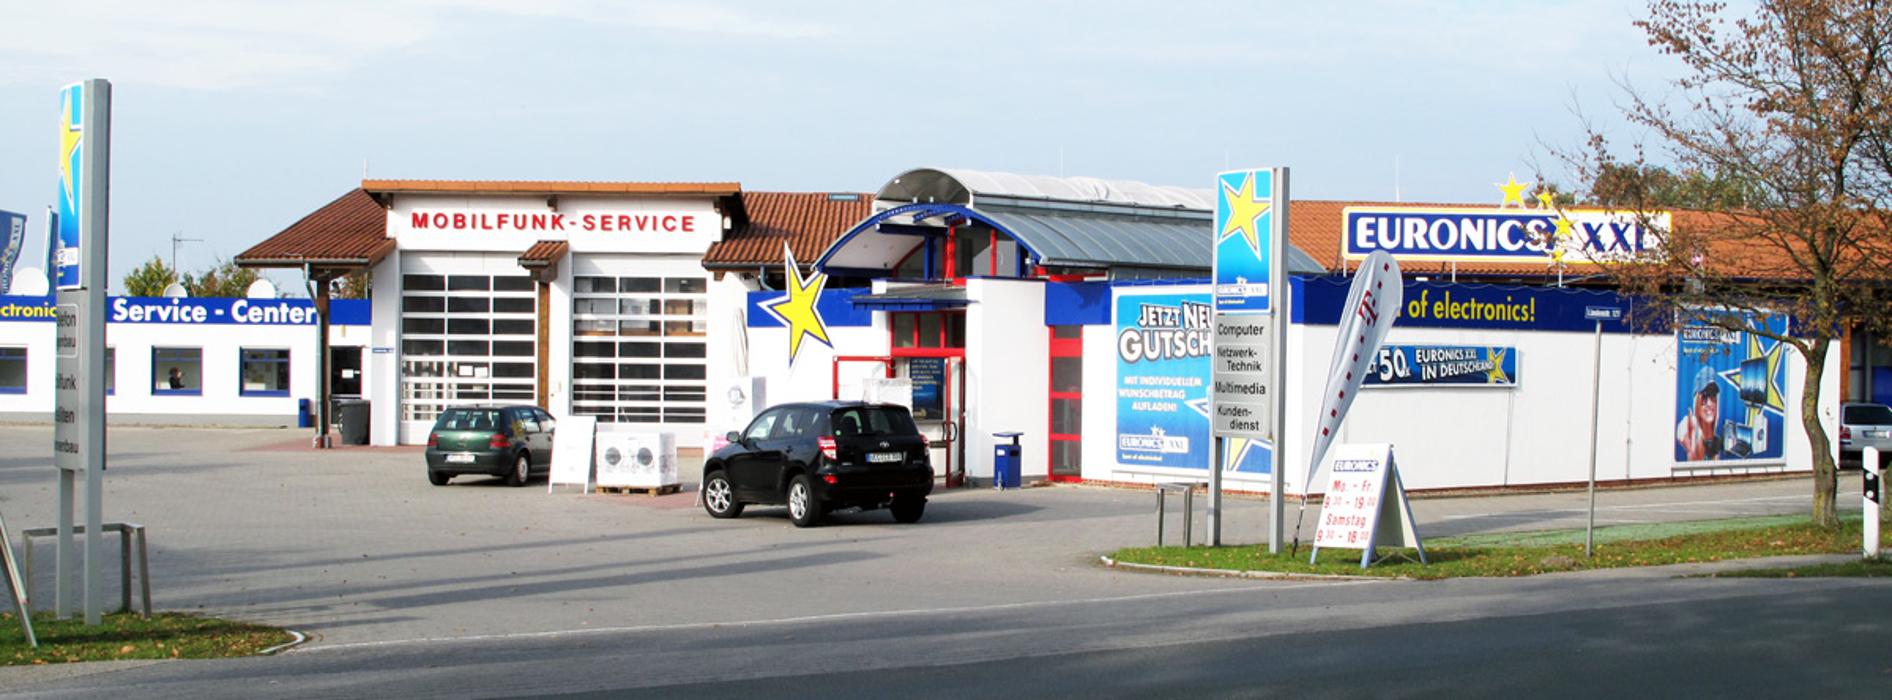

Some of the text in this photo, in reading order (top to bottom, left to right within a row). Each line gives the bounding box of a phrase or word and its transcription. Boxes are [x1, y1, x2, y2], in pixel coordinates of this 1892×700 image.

[411, 212, 695, 232] MOBILFUNK-SERVICE
[1356, 217, 1548, 251] EURONICS
[113, 298, 207, 323] Service
[232, 300, 318, 323] Center
[1408, 289, 1536, 321] of electronics!
[1138, 304, 1180, 327] JETZT
[1217, 323, 1265, 339] Computer
[1217, 347, 1258, 359] Netzwerk-
[1416, 348, 1464, 364] EURONICS
[1226, 360, 1262, 372] Technik
[1421, 360, 1495, 381] IN DEUTSCHLAND
[1215, 381, 1266, 395] Multimedia
[1217, 406, 1252, 418] Kunden-
[1229, 419, 1260, 431] dienst
[1335, 461, 1377, 472] EURONICS
[1326, 513, 1366, 529] Samstag
